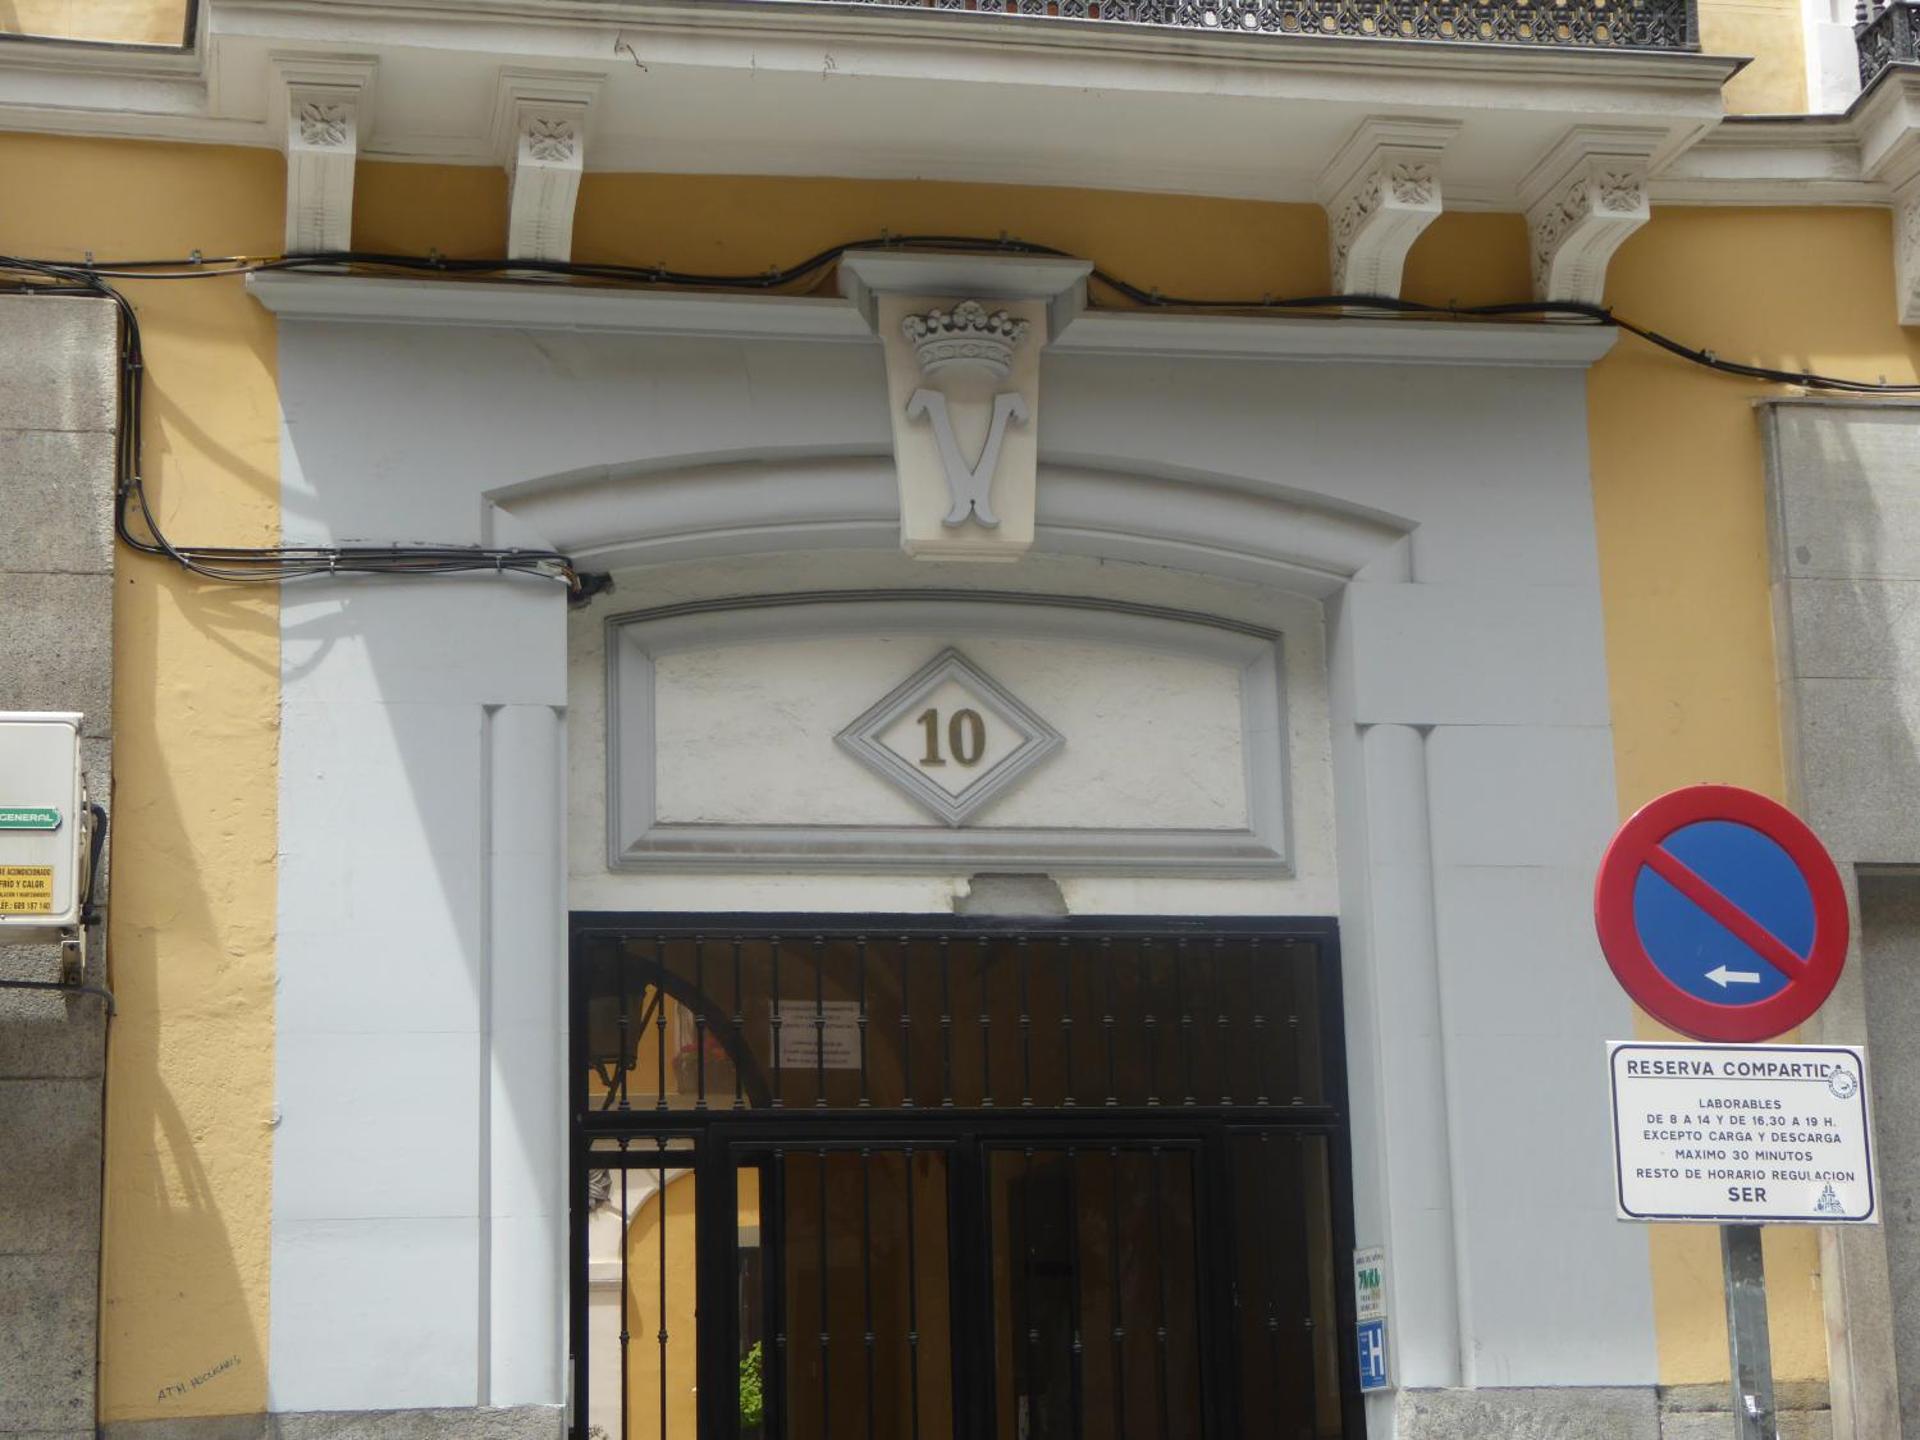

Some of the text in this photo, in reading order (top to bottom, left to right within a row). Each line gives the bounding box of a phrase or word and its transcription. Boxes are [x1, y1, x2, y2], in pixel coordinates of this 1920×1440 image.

[917, 708, 986, 767] 10
[0, 813, 54, 822] GENERAL
[22, 880, 45, 888] CALOR
[1627, 1060, 1714, 1076] RESERVA
[1698, 1098, 1782, 1110] LABORABLES
[1647, 1114, 1664, 1125] DE
[1670, 1114, 1678, 1125] 8
[1684, 1115, 1692, 1125] A
[1697, 1115, 1711, 1126] 14
[1716, 1115, 1724, 1126] Y
[1729, 1116, 1746, 1126] DE
[1792, 1116, 1800, 1127] A
[1806, 1116, 1818, 1127] 19
[1643, 1130, 1842, 1144] EXCEPTO CARGA Y DESCARGA
[1675, 1150, 1814, 1162] MAXIMO 30 MINUTOS
[1636, 1168, 1679, 1179] RESTO
[1685, 1169, 1702, 1180] DE
[1708, 1170, 1766, 1181] HORARIO
[1728, 1187, 1768, 1203] SER
